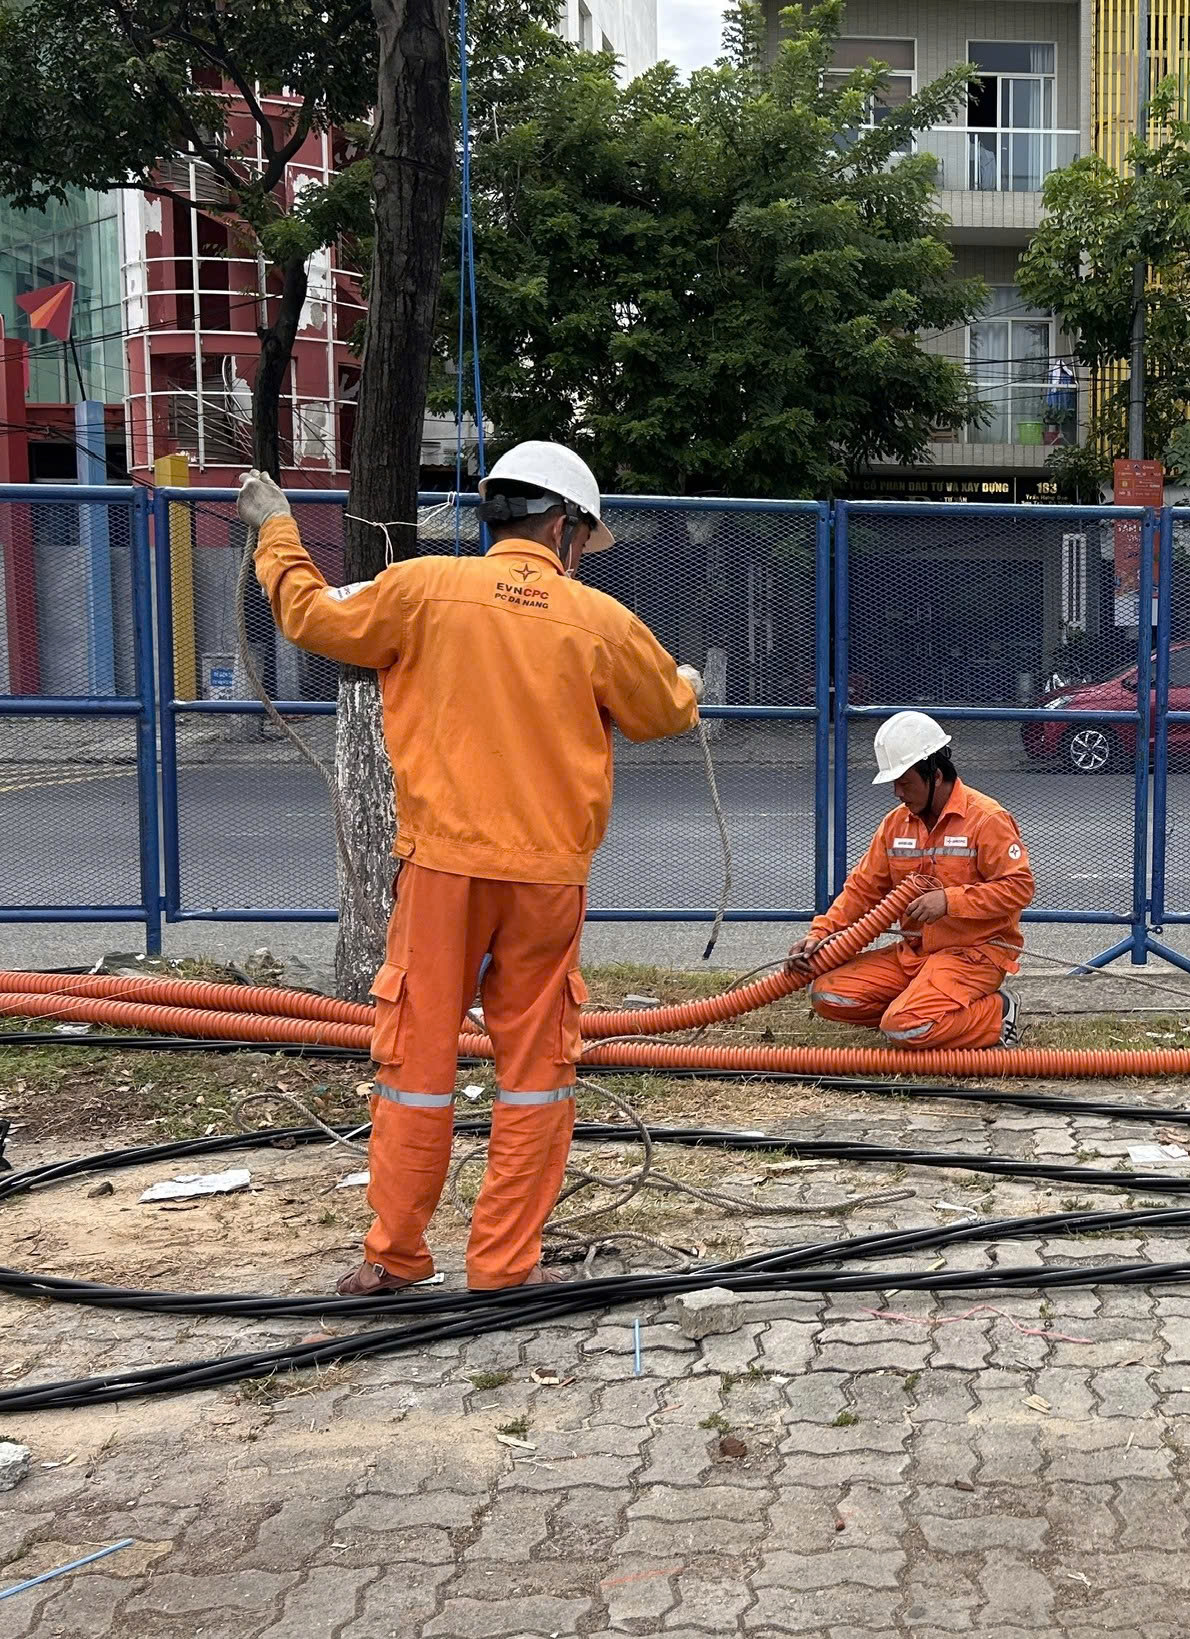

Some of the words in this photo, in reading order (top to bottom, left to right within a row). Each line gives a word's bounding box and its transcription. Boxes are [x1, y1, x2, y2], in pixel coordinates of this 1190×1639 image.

[981, 481, 1009, 495] DỰNG
[496, 582, 550, 600] EVNCPC
[494, 593, 507, 601] PC
[522, 599, 549, 609] NANG
